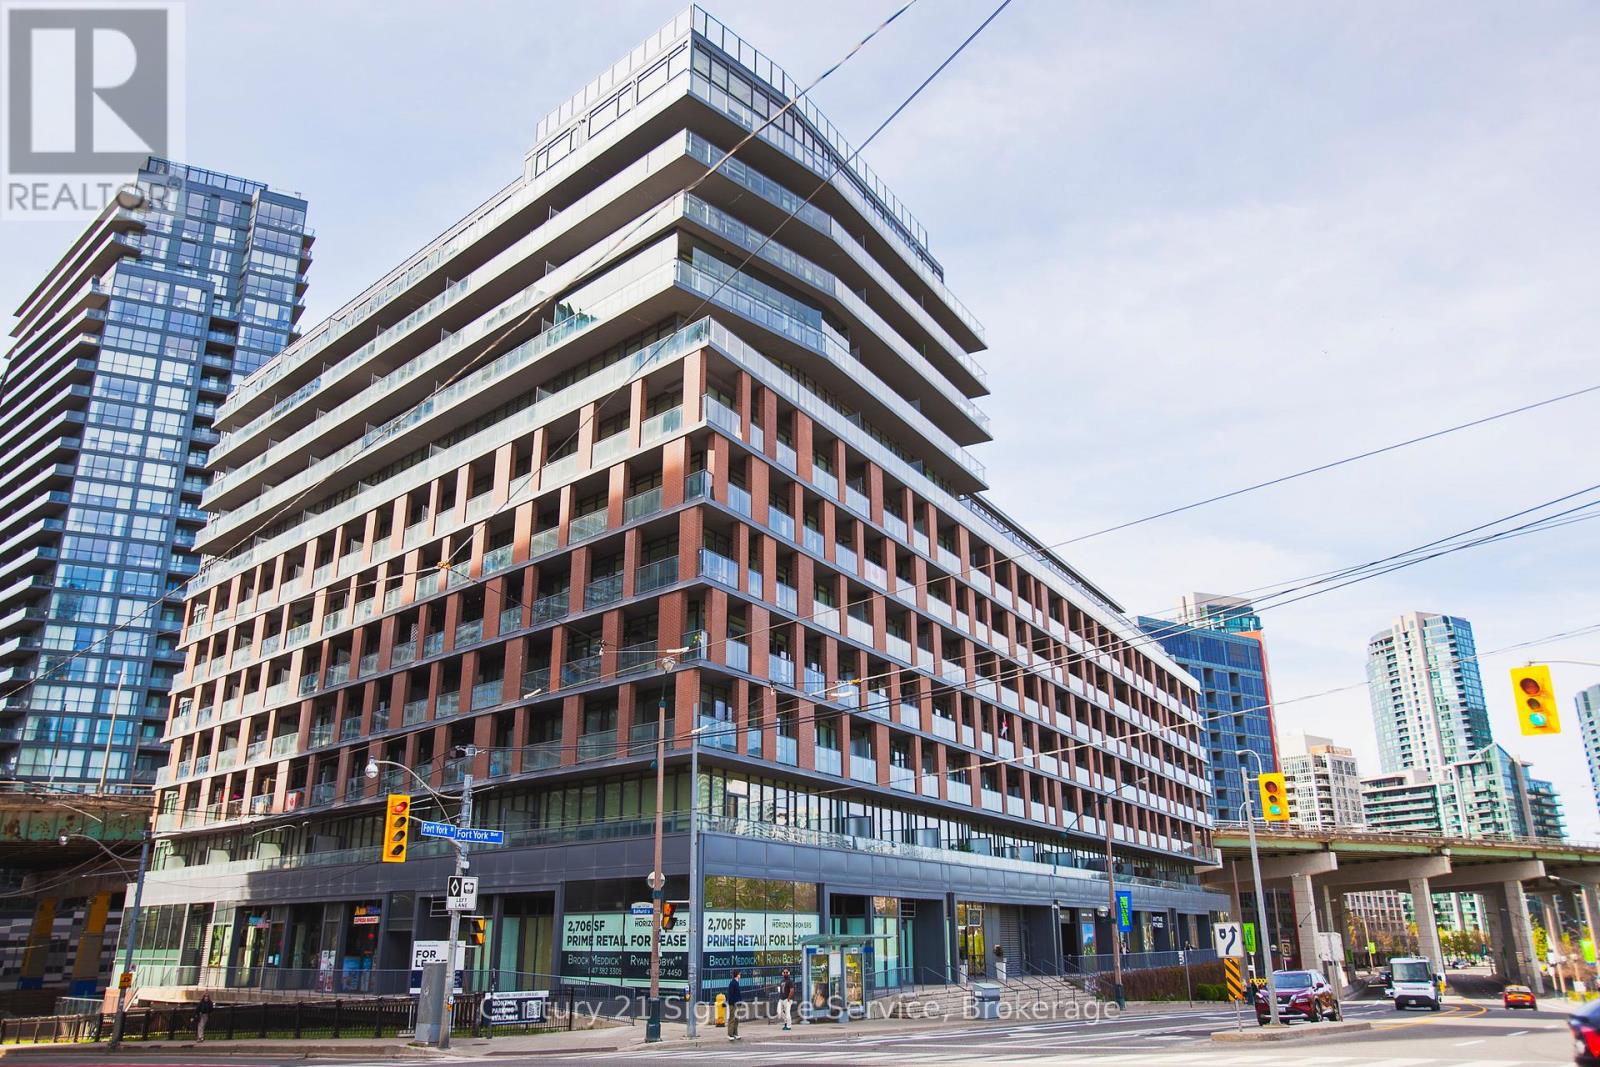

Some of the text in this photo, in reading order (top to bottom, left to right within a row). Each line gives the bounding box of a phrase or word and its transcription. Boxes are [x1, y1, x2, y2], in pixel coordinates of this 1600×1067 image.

[423, 823, 435, 833] Fort
[436, 825, 448, 835] York
[456, 829, 473, 838] Fort
[473, 830, 489, 840] York
[568, 921, 605, 934] 2,706 SF
[634, 920, 653, 928] HORIZ
[708, 918, 746, 932] 2,706 SF
[567, 935, 687, 947] PRIME RETAIL FOR EASE
[707, 935, 735, 946] PRIME
[768, 934, 786, 947] FOR
[415, 950, 437, 959] FOR
[667, 969, 682, 977] 4450
